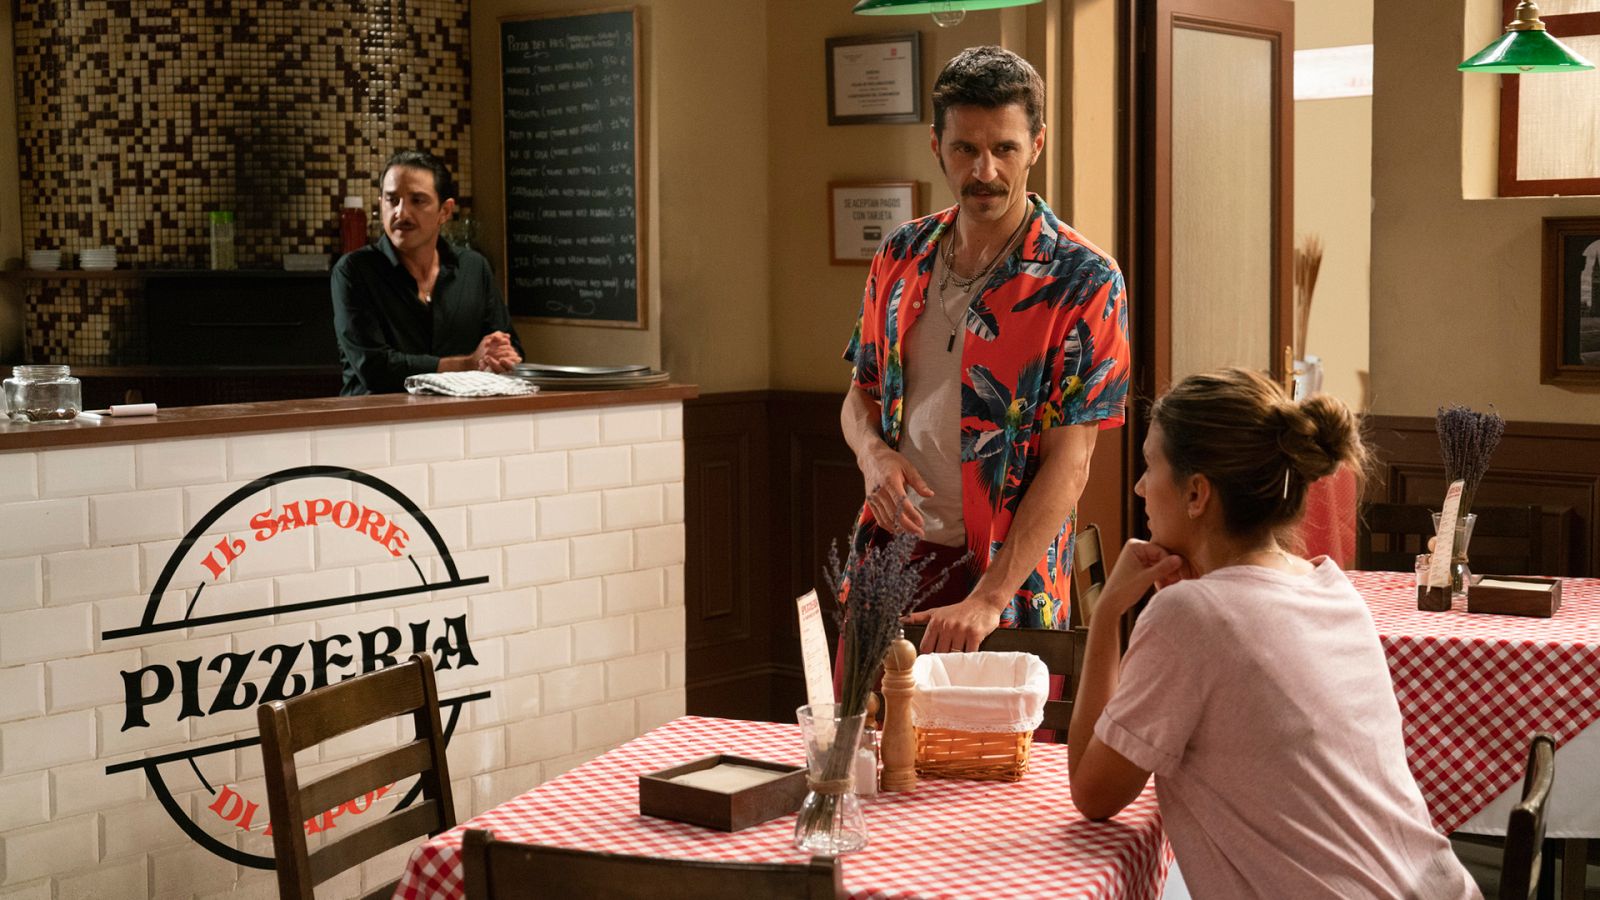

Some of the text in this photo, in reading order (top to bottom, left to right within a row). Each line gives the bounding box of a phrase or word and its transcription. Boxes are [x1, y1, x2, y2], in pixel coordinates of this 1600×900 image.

[844, 197, 901, 208] SE ACEPTAN PAGOS
[853, 210, 892, 220] CON TARJETA
[201, 498, 410, 580] IL SAPORE
[119, 613, 479, 732] PIZZERIA
[208, 784, 260, 832] DI
